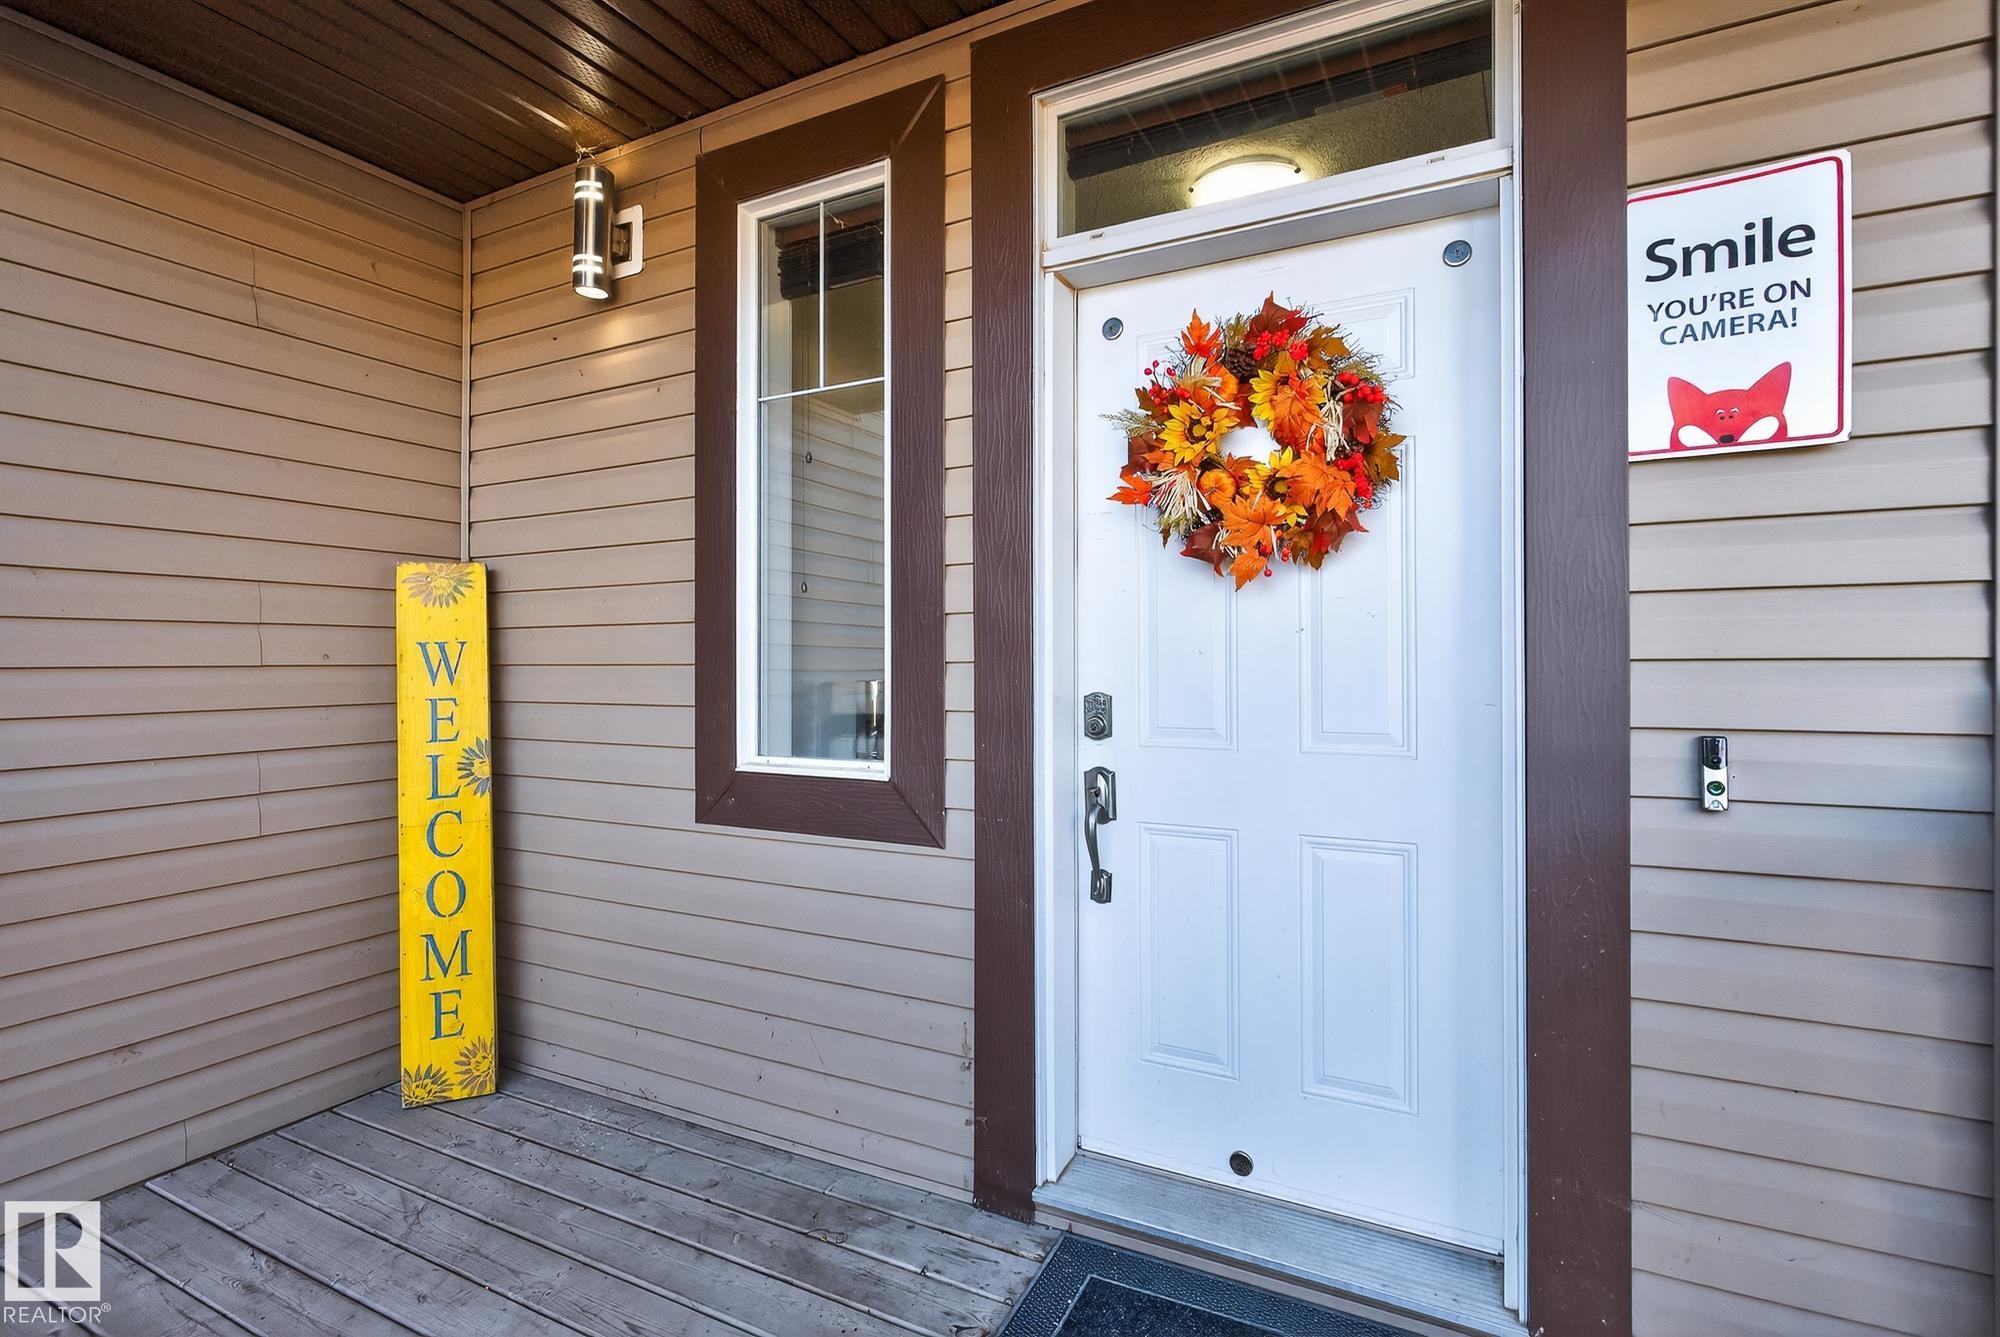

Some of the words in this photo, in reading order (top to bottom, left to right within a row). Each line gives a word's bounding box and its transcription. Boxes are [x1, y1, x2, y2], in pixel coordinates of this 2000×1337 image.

[1644, 216, 1816, 283] Smile
[1647, 287, 1755, 322] YOU'RE
[1763, 278, 1812, 304] ON
[1659, 307, 1798, 346] CAMERA!
[415, 640, 472, 1041] WELCOME
